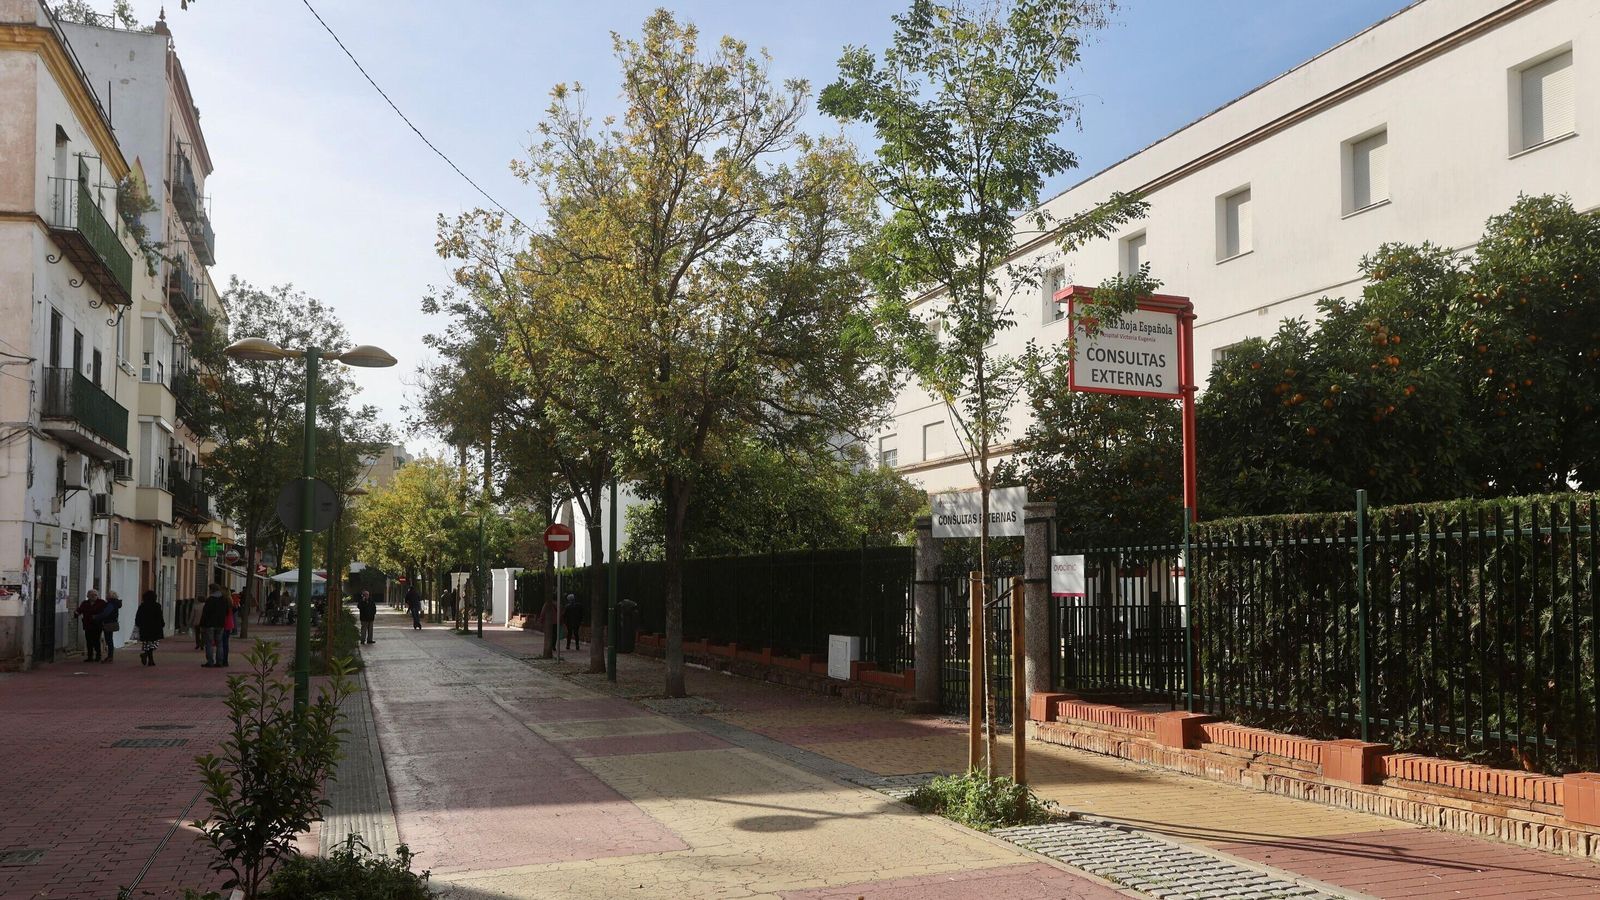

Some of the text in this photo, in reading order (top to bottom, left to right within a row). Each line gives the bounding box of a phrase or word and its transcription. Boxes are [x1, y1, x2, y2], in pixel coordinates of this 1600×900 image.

[1120, 319, 1138, 333] Roja
[1139, 321, 1173, 335] Española
[1120, 333, 1137, 341] Victoria
[1086, 347, 1166, 368] CONSULTAS
[1091, 369, 1163, 388] EXTERNAS
[938, 511, 1017, 526] CONSULTAS ETERNAS
